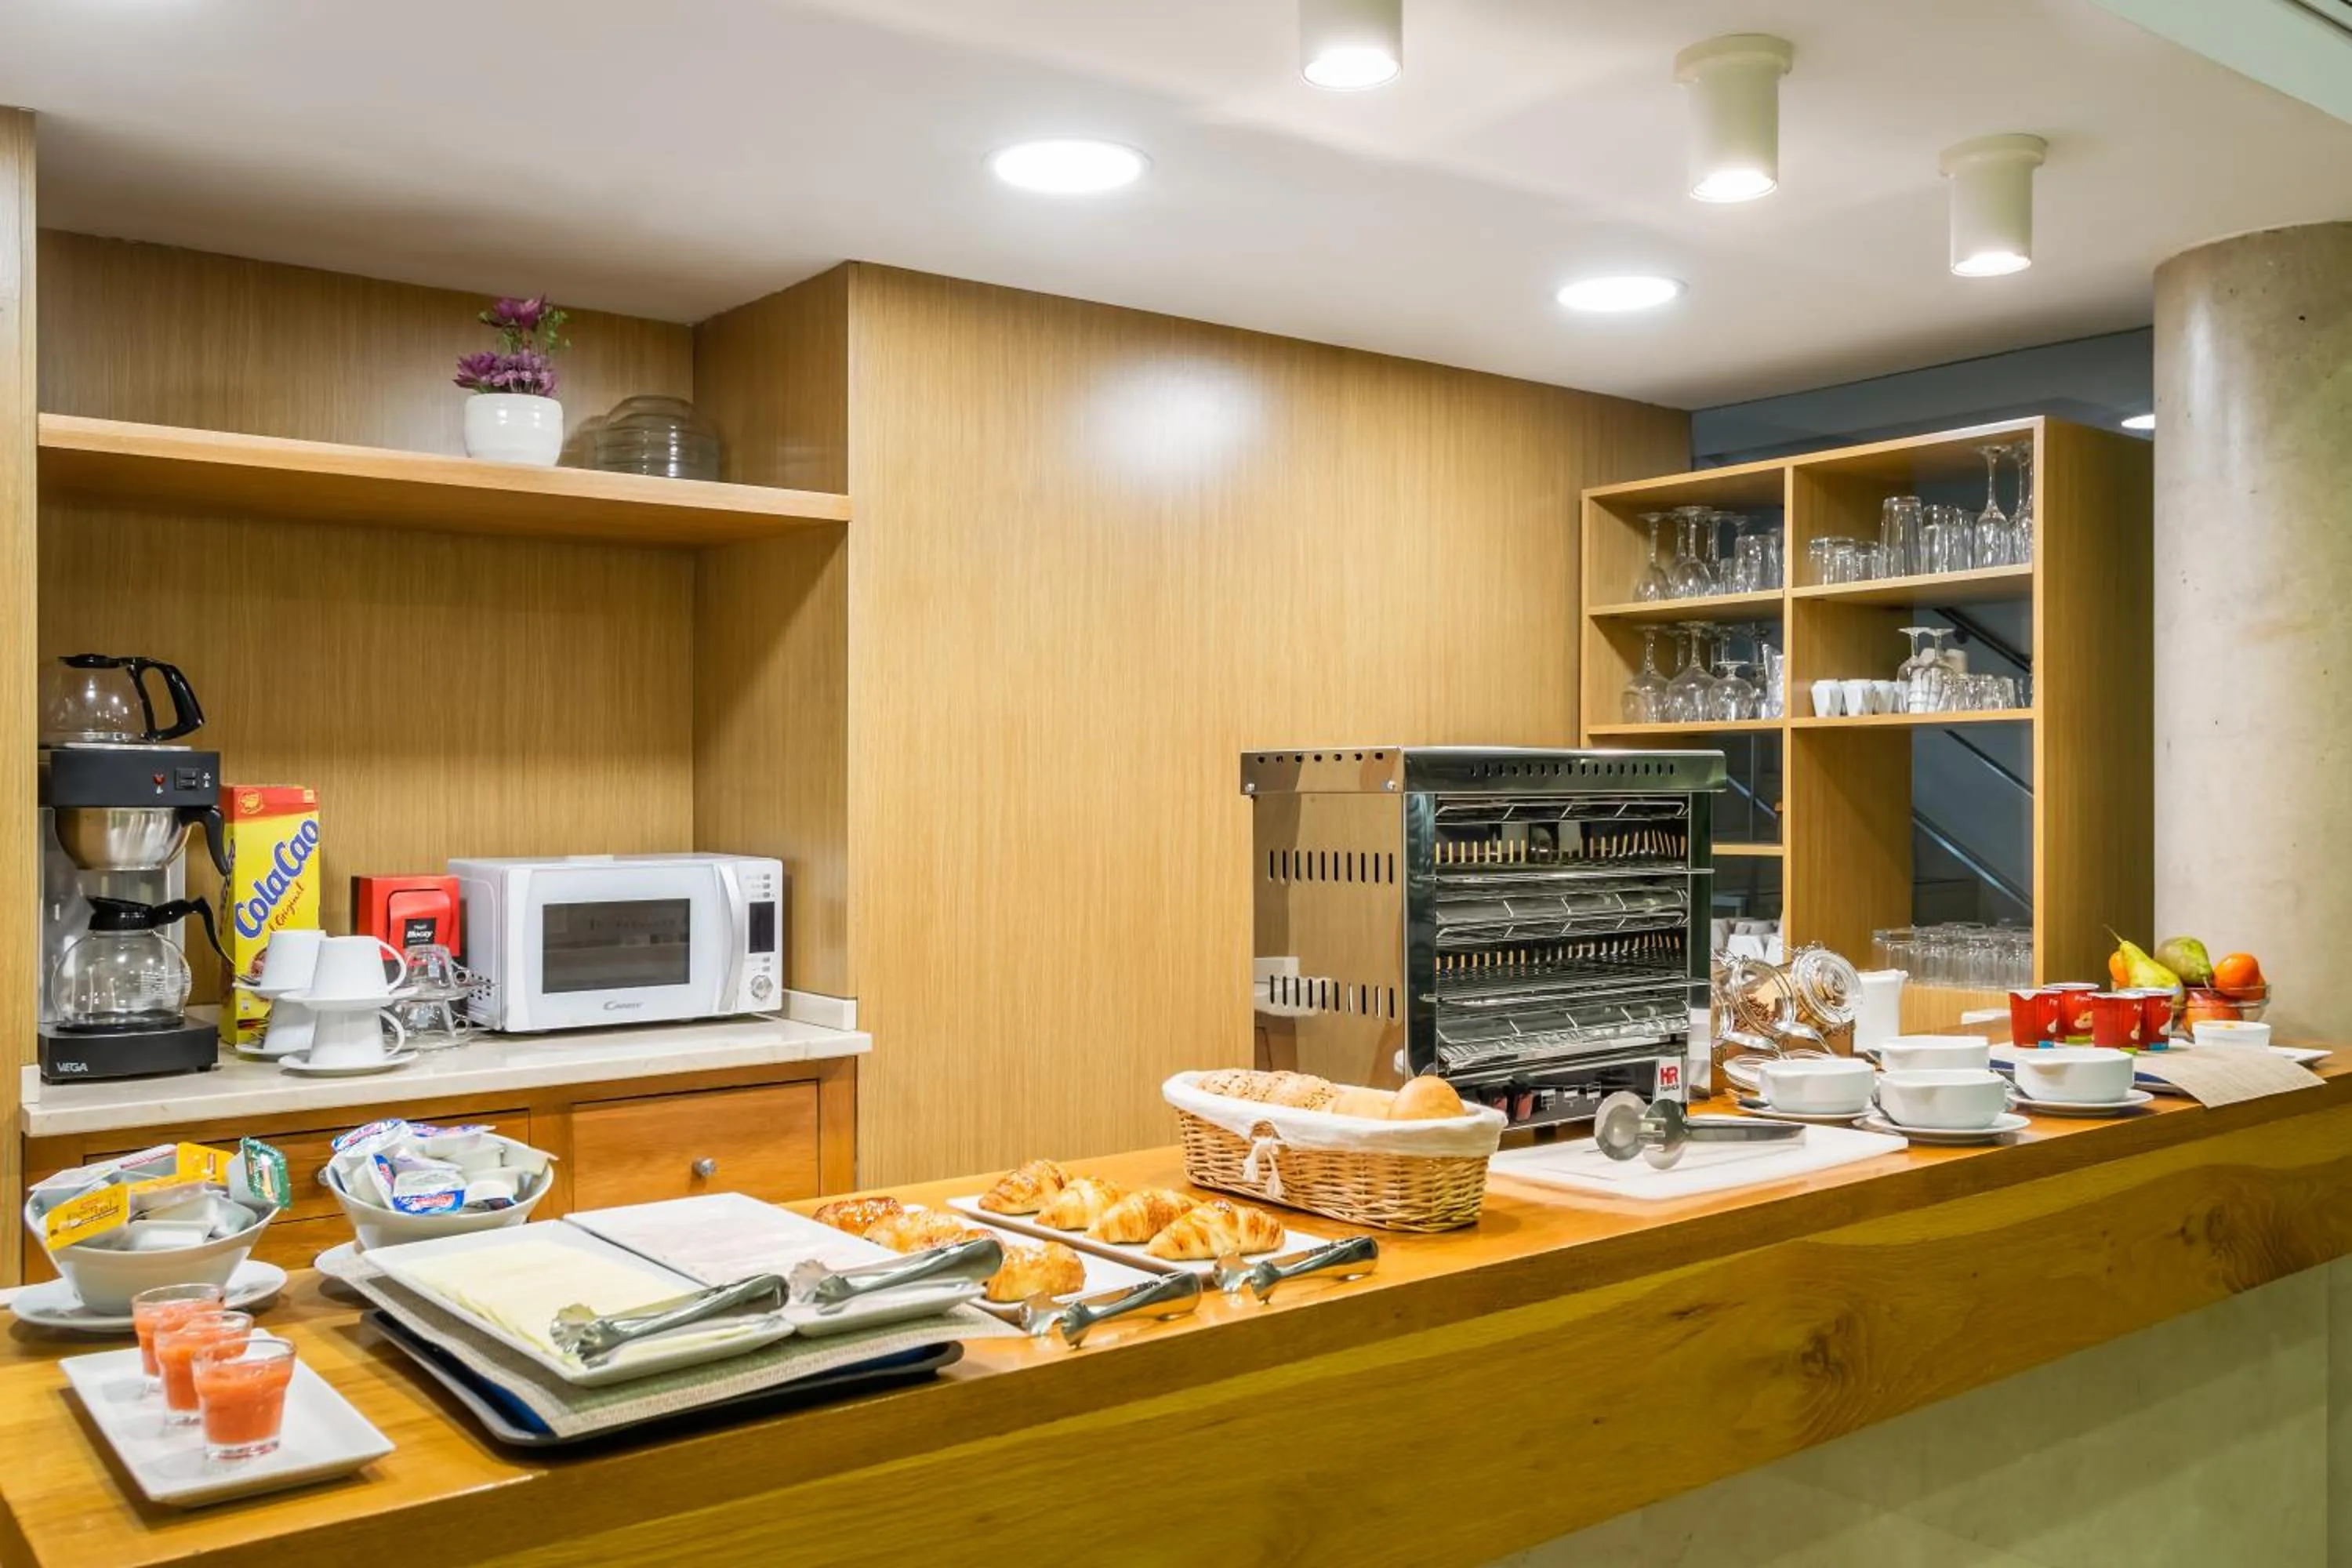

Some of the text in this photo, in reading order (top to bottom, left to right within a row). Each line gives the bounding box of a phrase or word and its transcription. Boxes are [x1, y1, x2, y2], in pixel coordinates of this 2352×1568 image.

[235, 819, 318, 938] ColaCao
[56, 1062, 89, 1073] VEGA
[1660, 1066, 1679, 1085] HR
